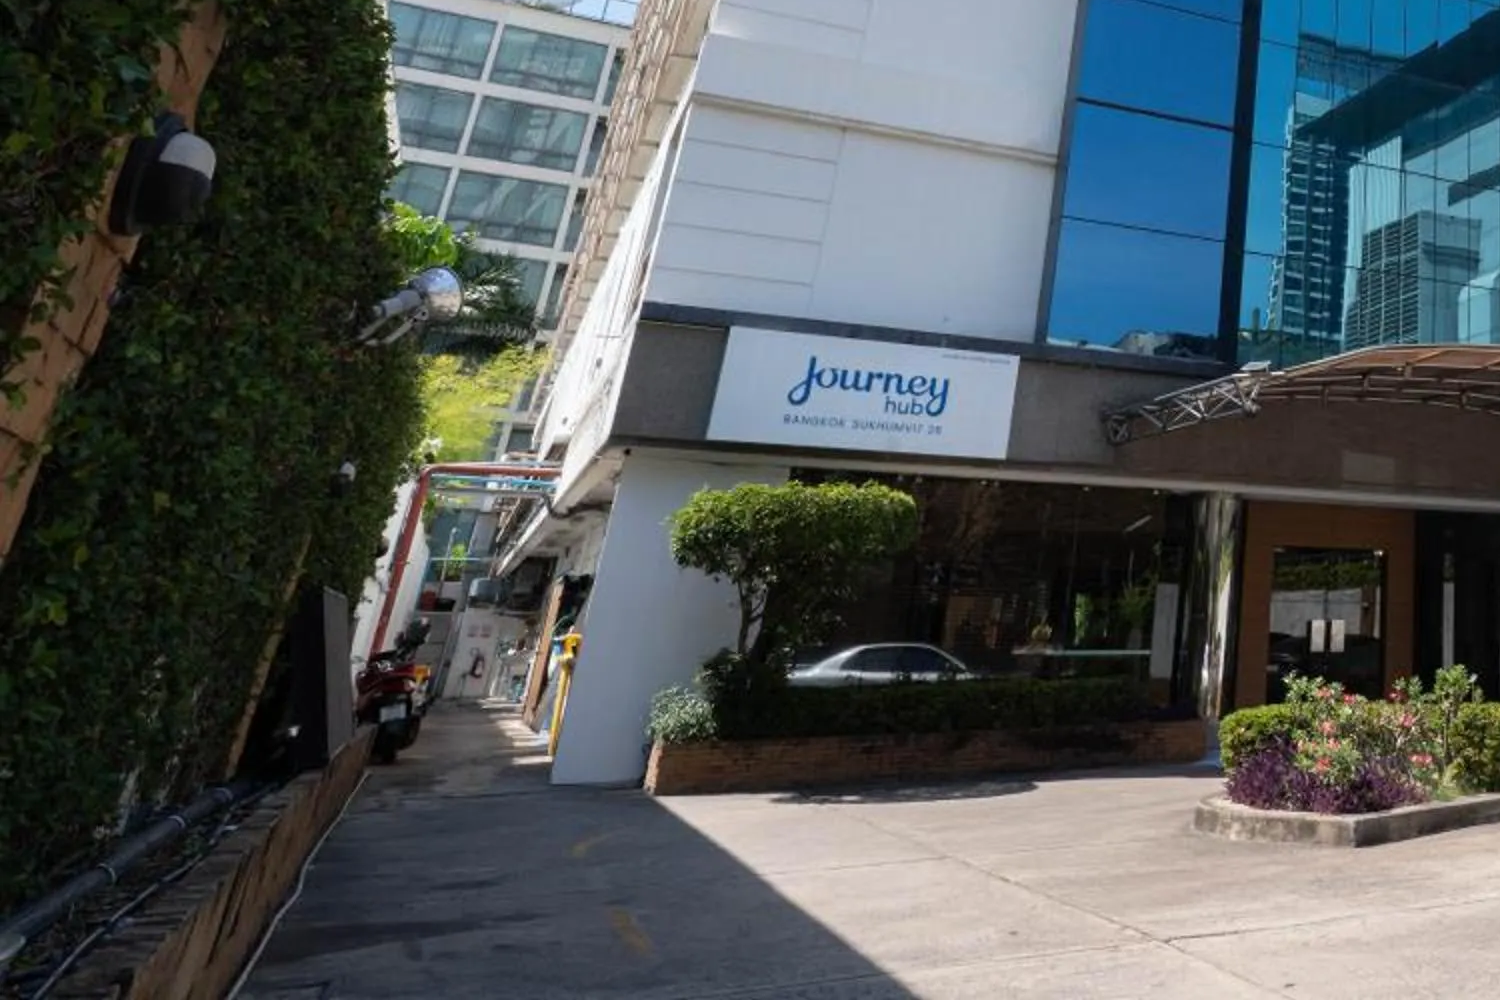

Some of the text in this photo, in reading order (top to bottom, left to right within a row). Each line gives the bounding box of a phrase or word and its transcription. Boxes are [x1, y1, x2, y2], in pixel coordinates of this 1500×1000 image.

[885, 396, 924, 416] hub
[783, 413, 846, 428] BANGKOK
[851, 416, 924, 435] SUKHUMVIT
